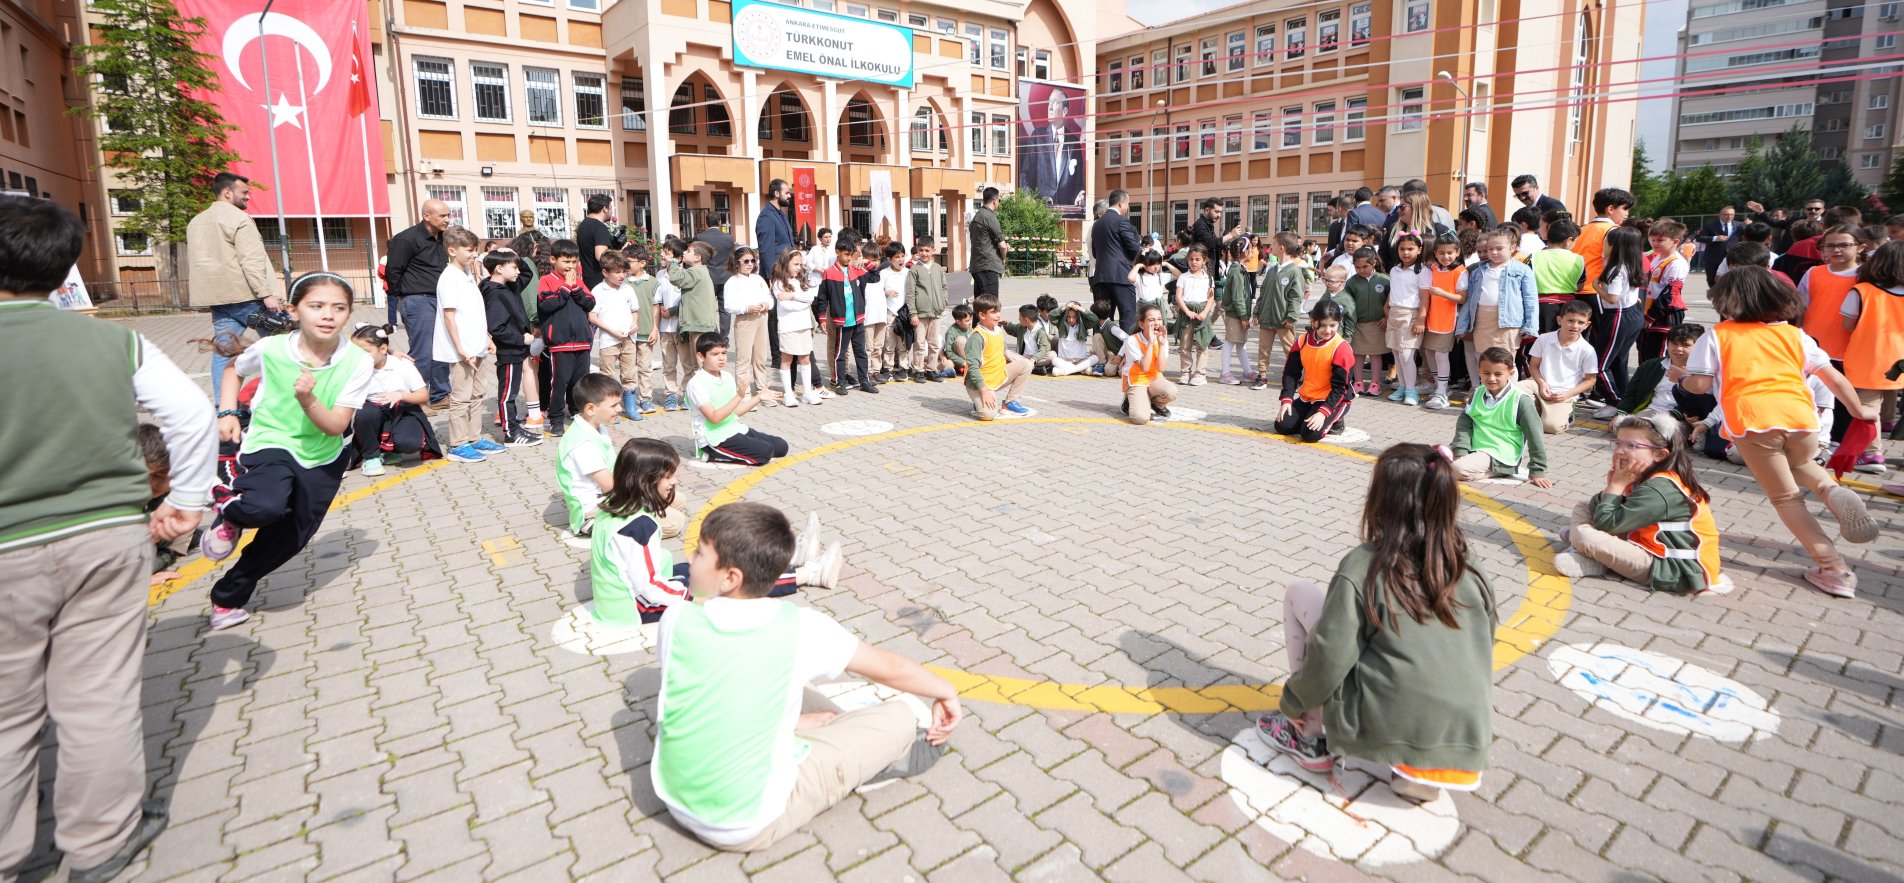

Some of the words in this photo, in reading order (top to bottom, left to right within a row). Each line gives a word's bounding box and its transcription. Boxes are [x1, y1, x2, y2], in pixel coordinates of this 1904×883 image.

[785, 31, 854, 52] TÜRKKONUT
[786, 50, 816, 64] EMEL
[819, 54, 848, 68] ÖNAL
[850, 57, 901, 75] İLKOKULU
